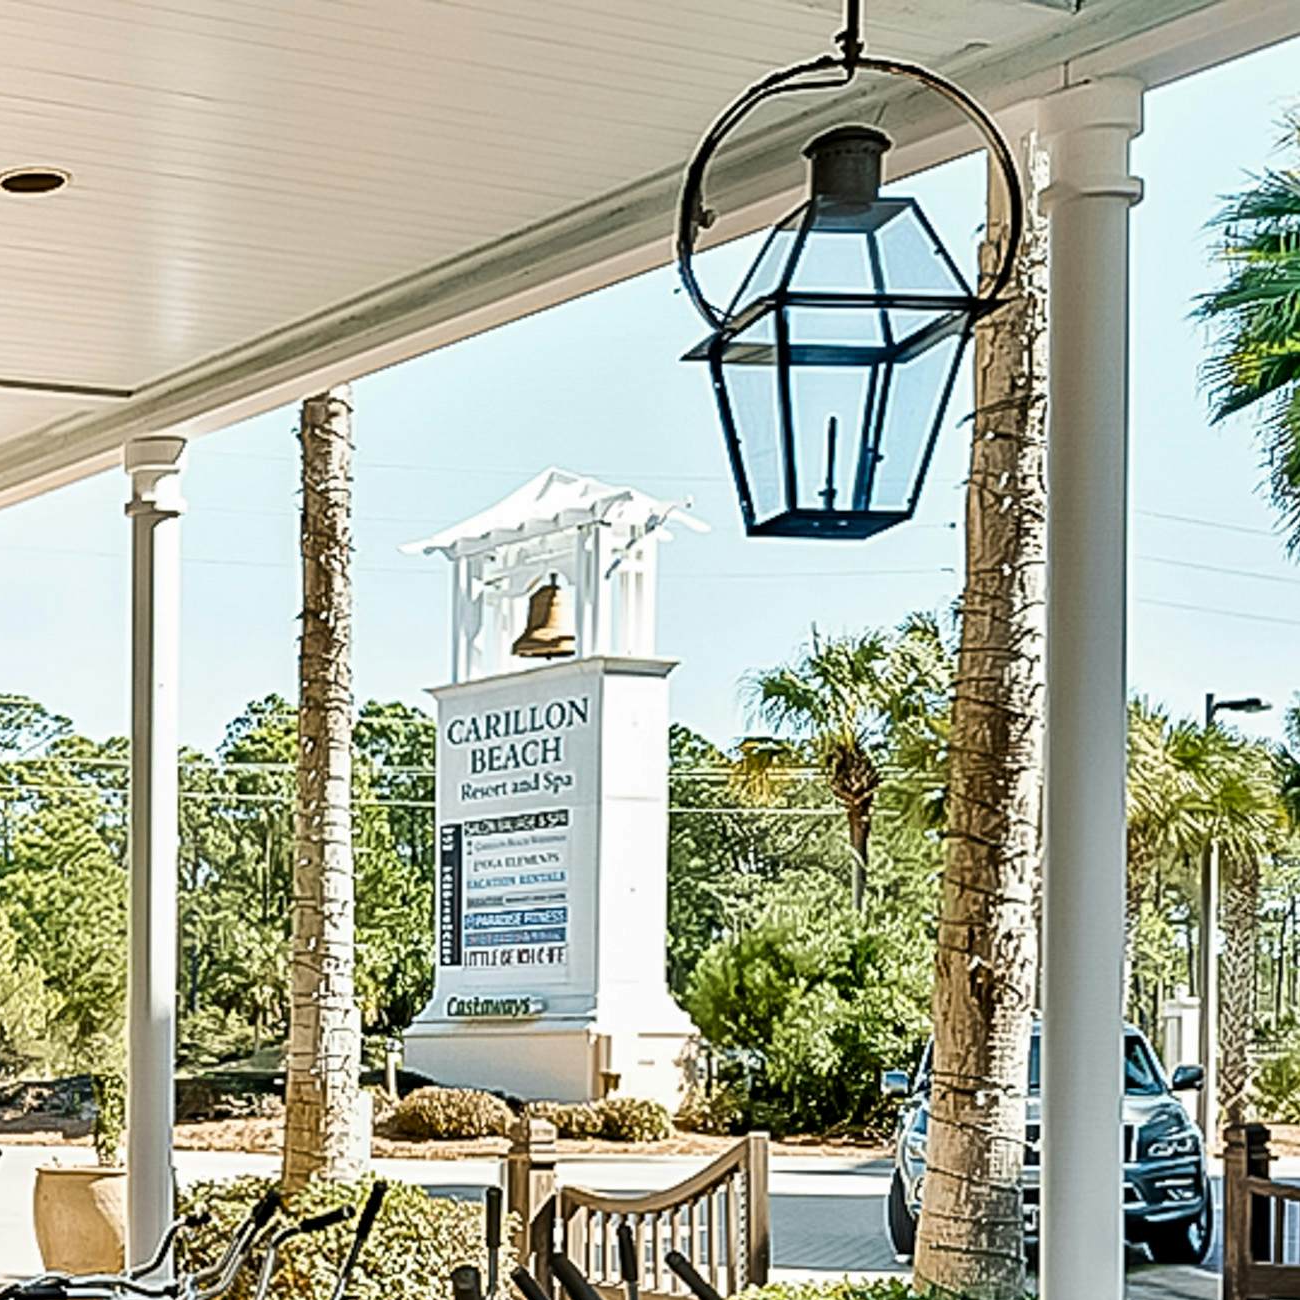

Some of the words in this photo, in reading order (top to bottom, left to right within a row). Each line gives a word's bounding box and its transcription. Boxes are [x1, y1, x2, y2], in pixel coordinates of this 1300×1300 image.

[447, 697, 588, 745] CARILLON
[471, 736, 562, 774] BEACH
[461, 782, 507, 800] Resort
[512, 773, 540, 793] and
[543, 771, 573, 794] Spa
[447, 996, 531, 1017] Castaways
